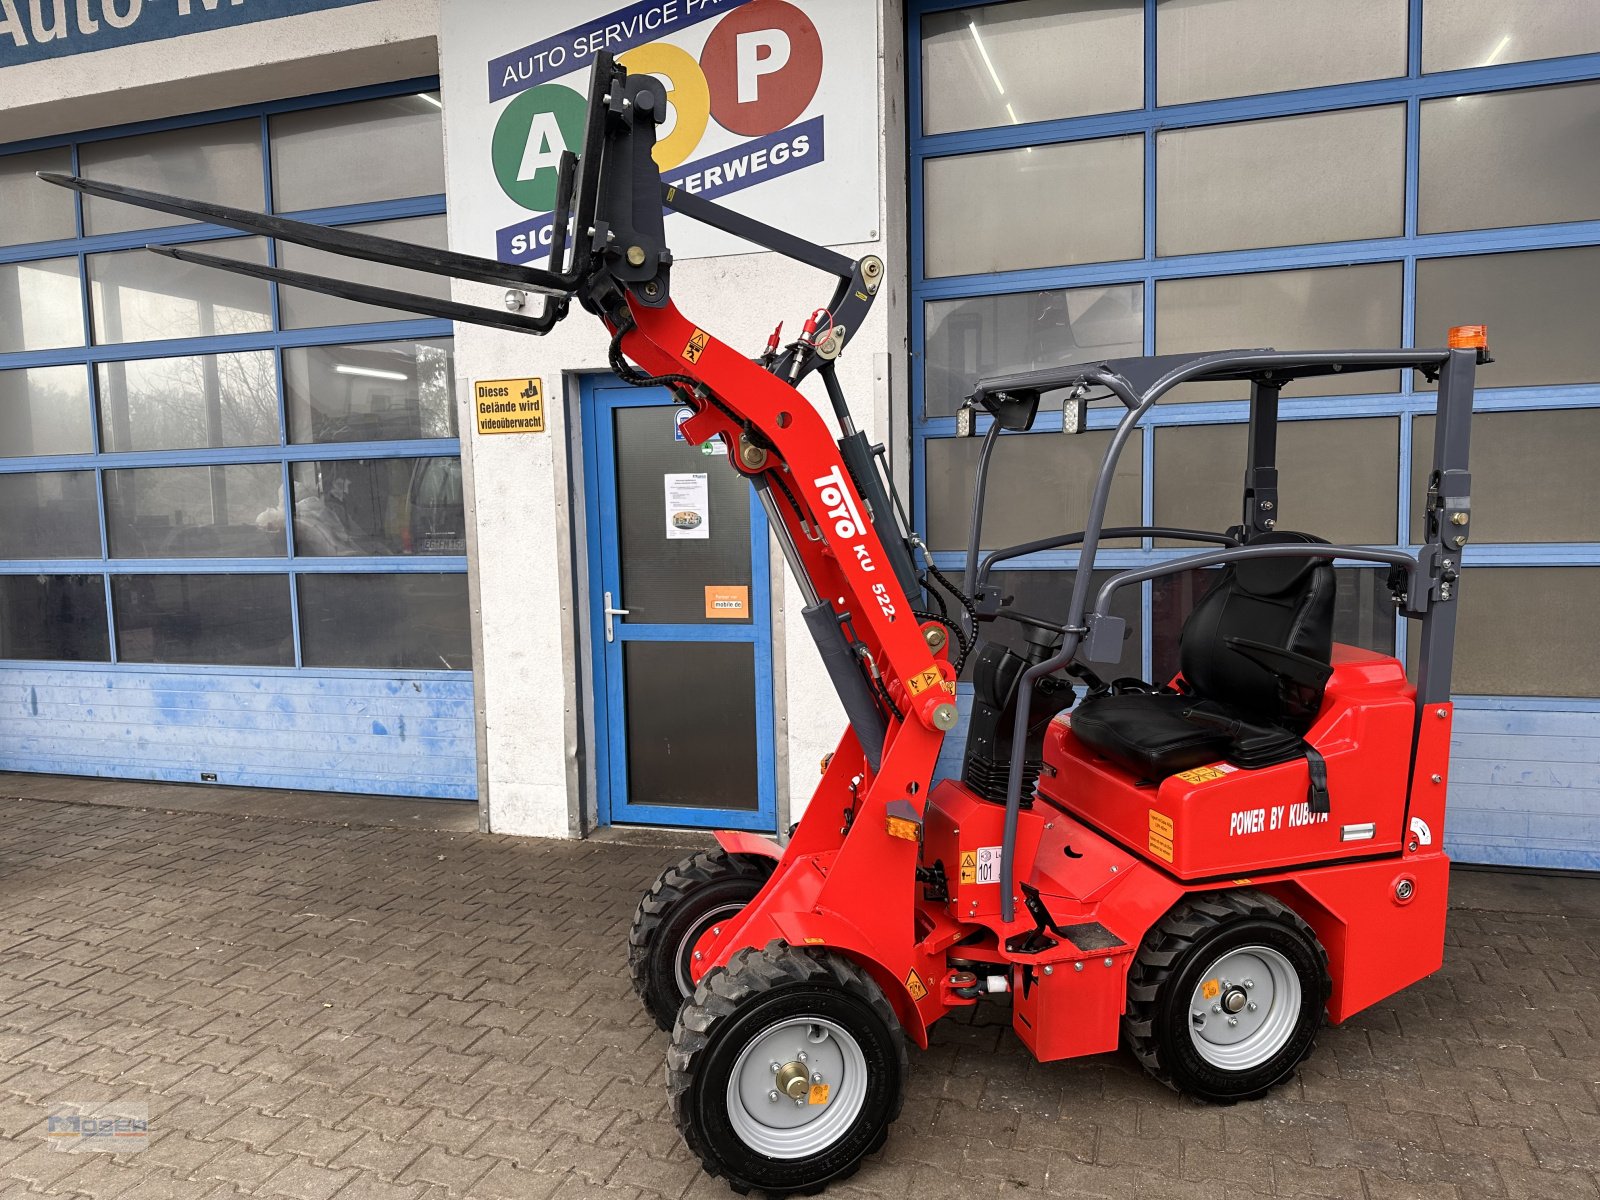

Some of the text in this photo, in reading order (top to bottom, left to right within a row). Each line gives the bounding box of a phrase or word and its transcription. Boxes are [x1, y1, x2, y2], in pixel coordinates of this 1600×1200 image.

[502, 46, 566, 87] AUTO
[573, 0, 678, 58] SERVICE
[736, 29, 791, 103] P
[517, 111, 568, 181] A
[478, 386, 509, 398] Dieses
[479, 400, 540, 414] Gelände wird
[480, 416, 542, 430] videoüberwacht
[813, 465, 896, 617] TOYO KU 522
[715, 600, 742, 608] mobile.de
[1229, 808, 1265, 837] POWER
[1269, 805, 1285, 831] BY
[979, 863, 992, 881] 101
